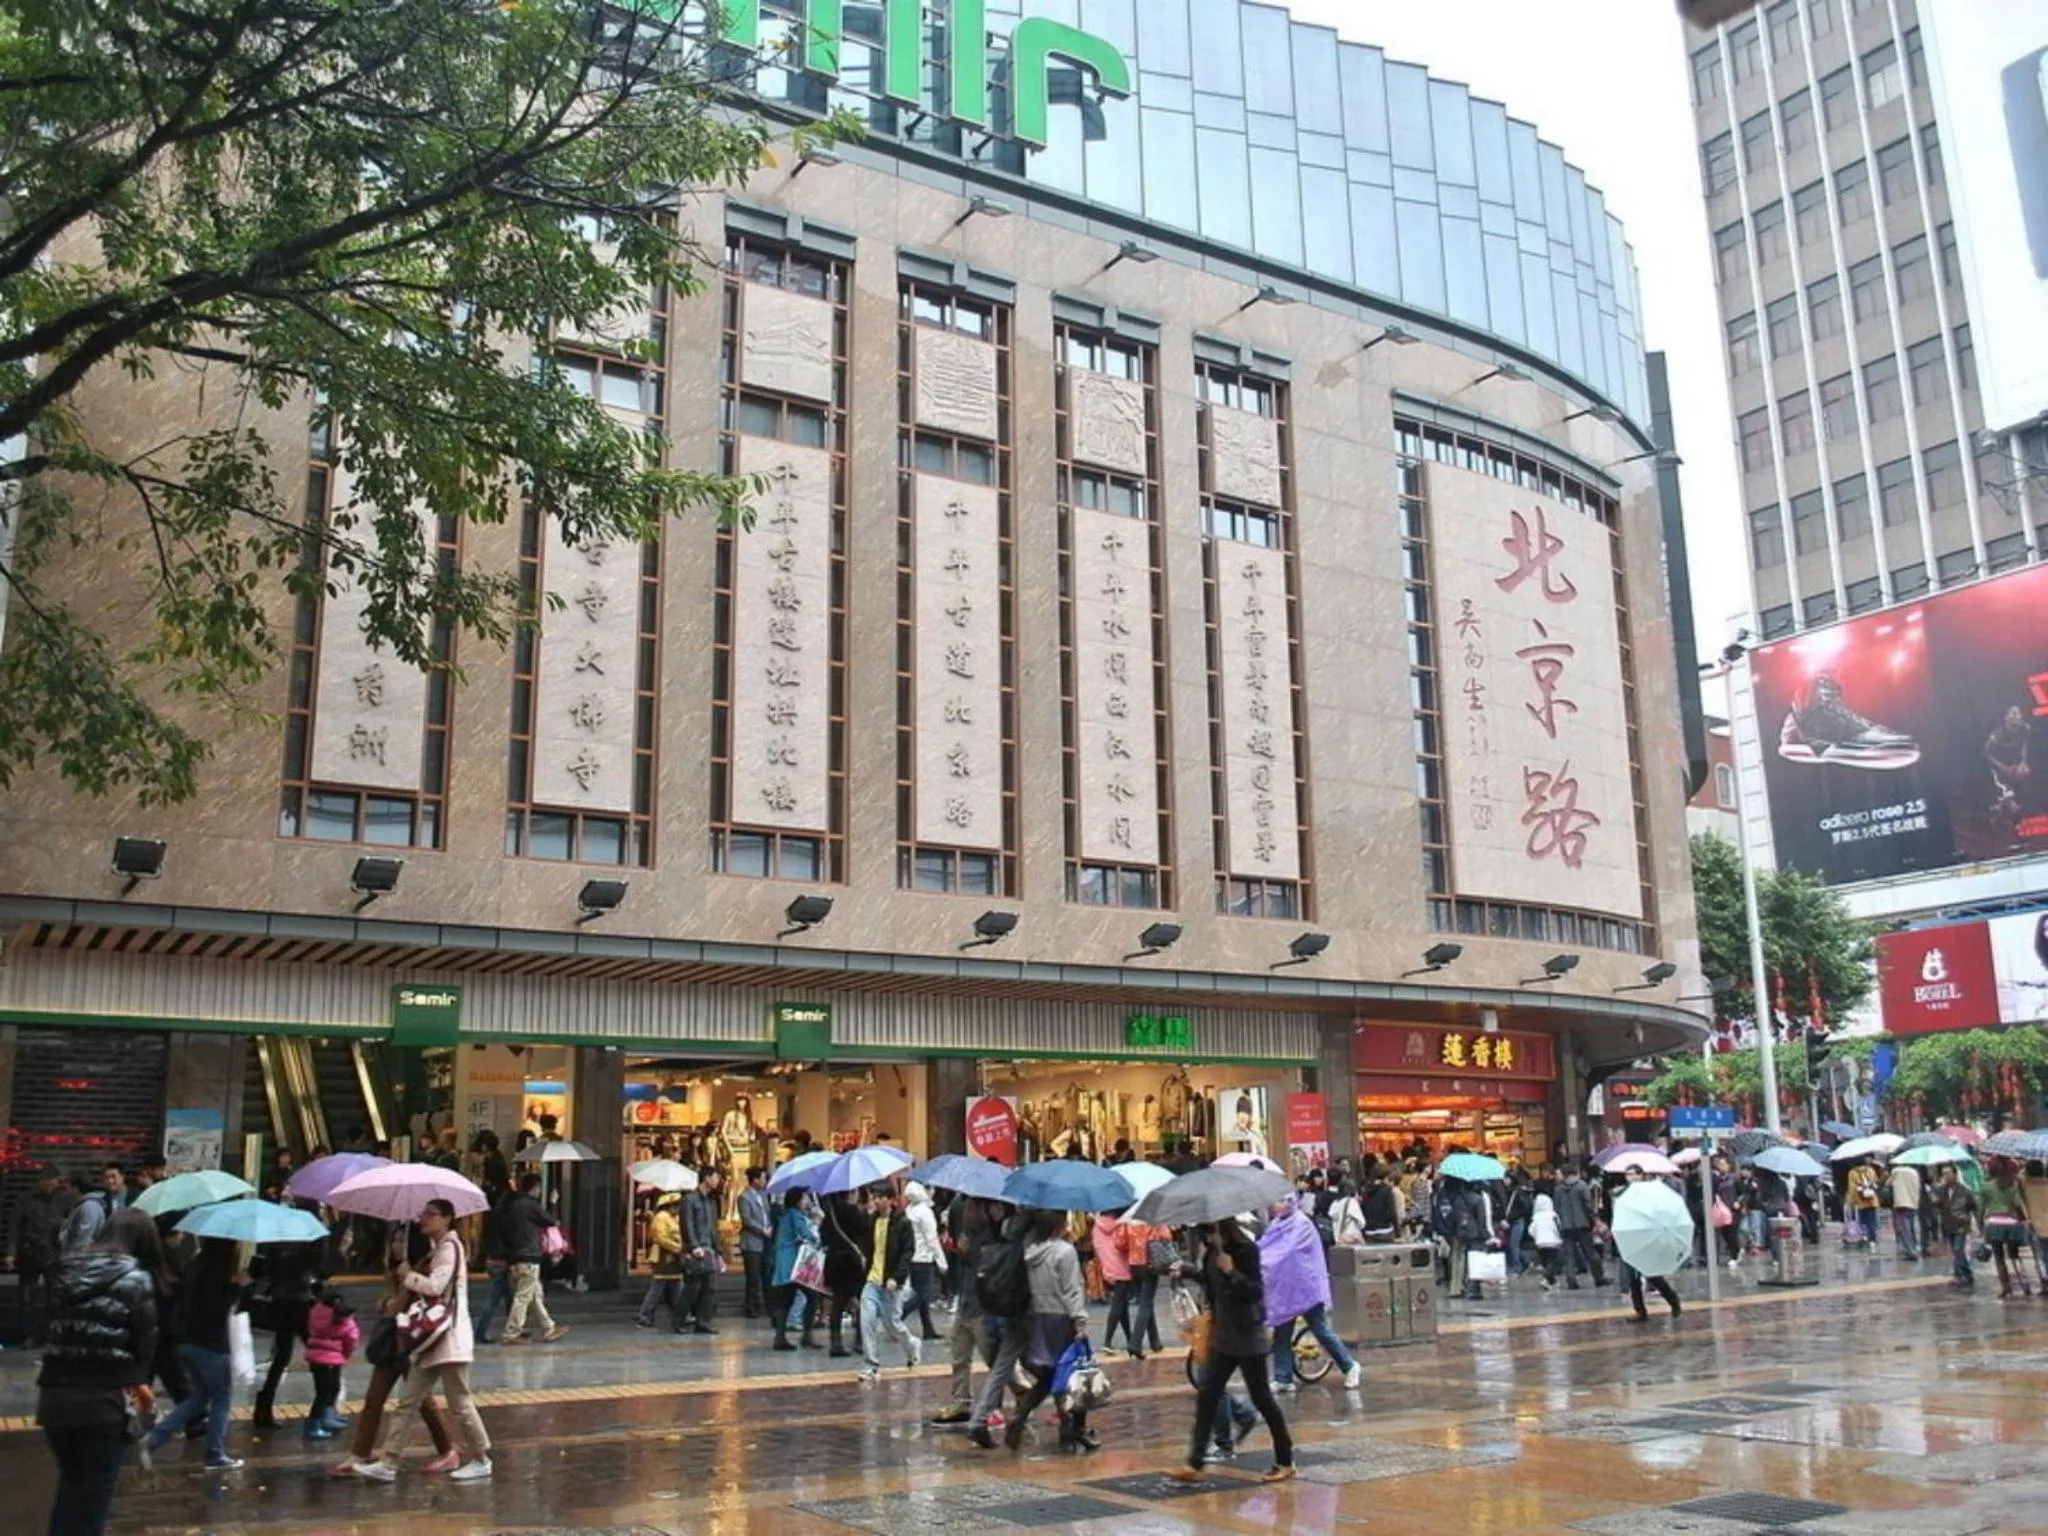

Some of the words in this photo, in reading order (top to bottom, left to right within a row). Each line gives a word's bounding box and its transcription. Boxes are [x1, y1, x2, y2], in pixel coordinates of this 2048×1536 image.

[1494, 505, 1600, 869] 北京路
[1442, 1032, 1515, 1071] 蓮香樓
